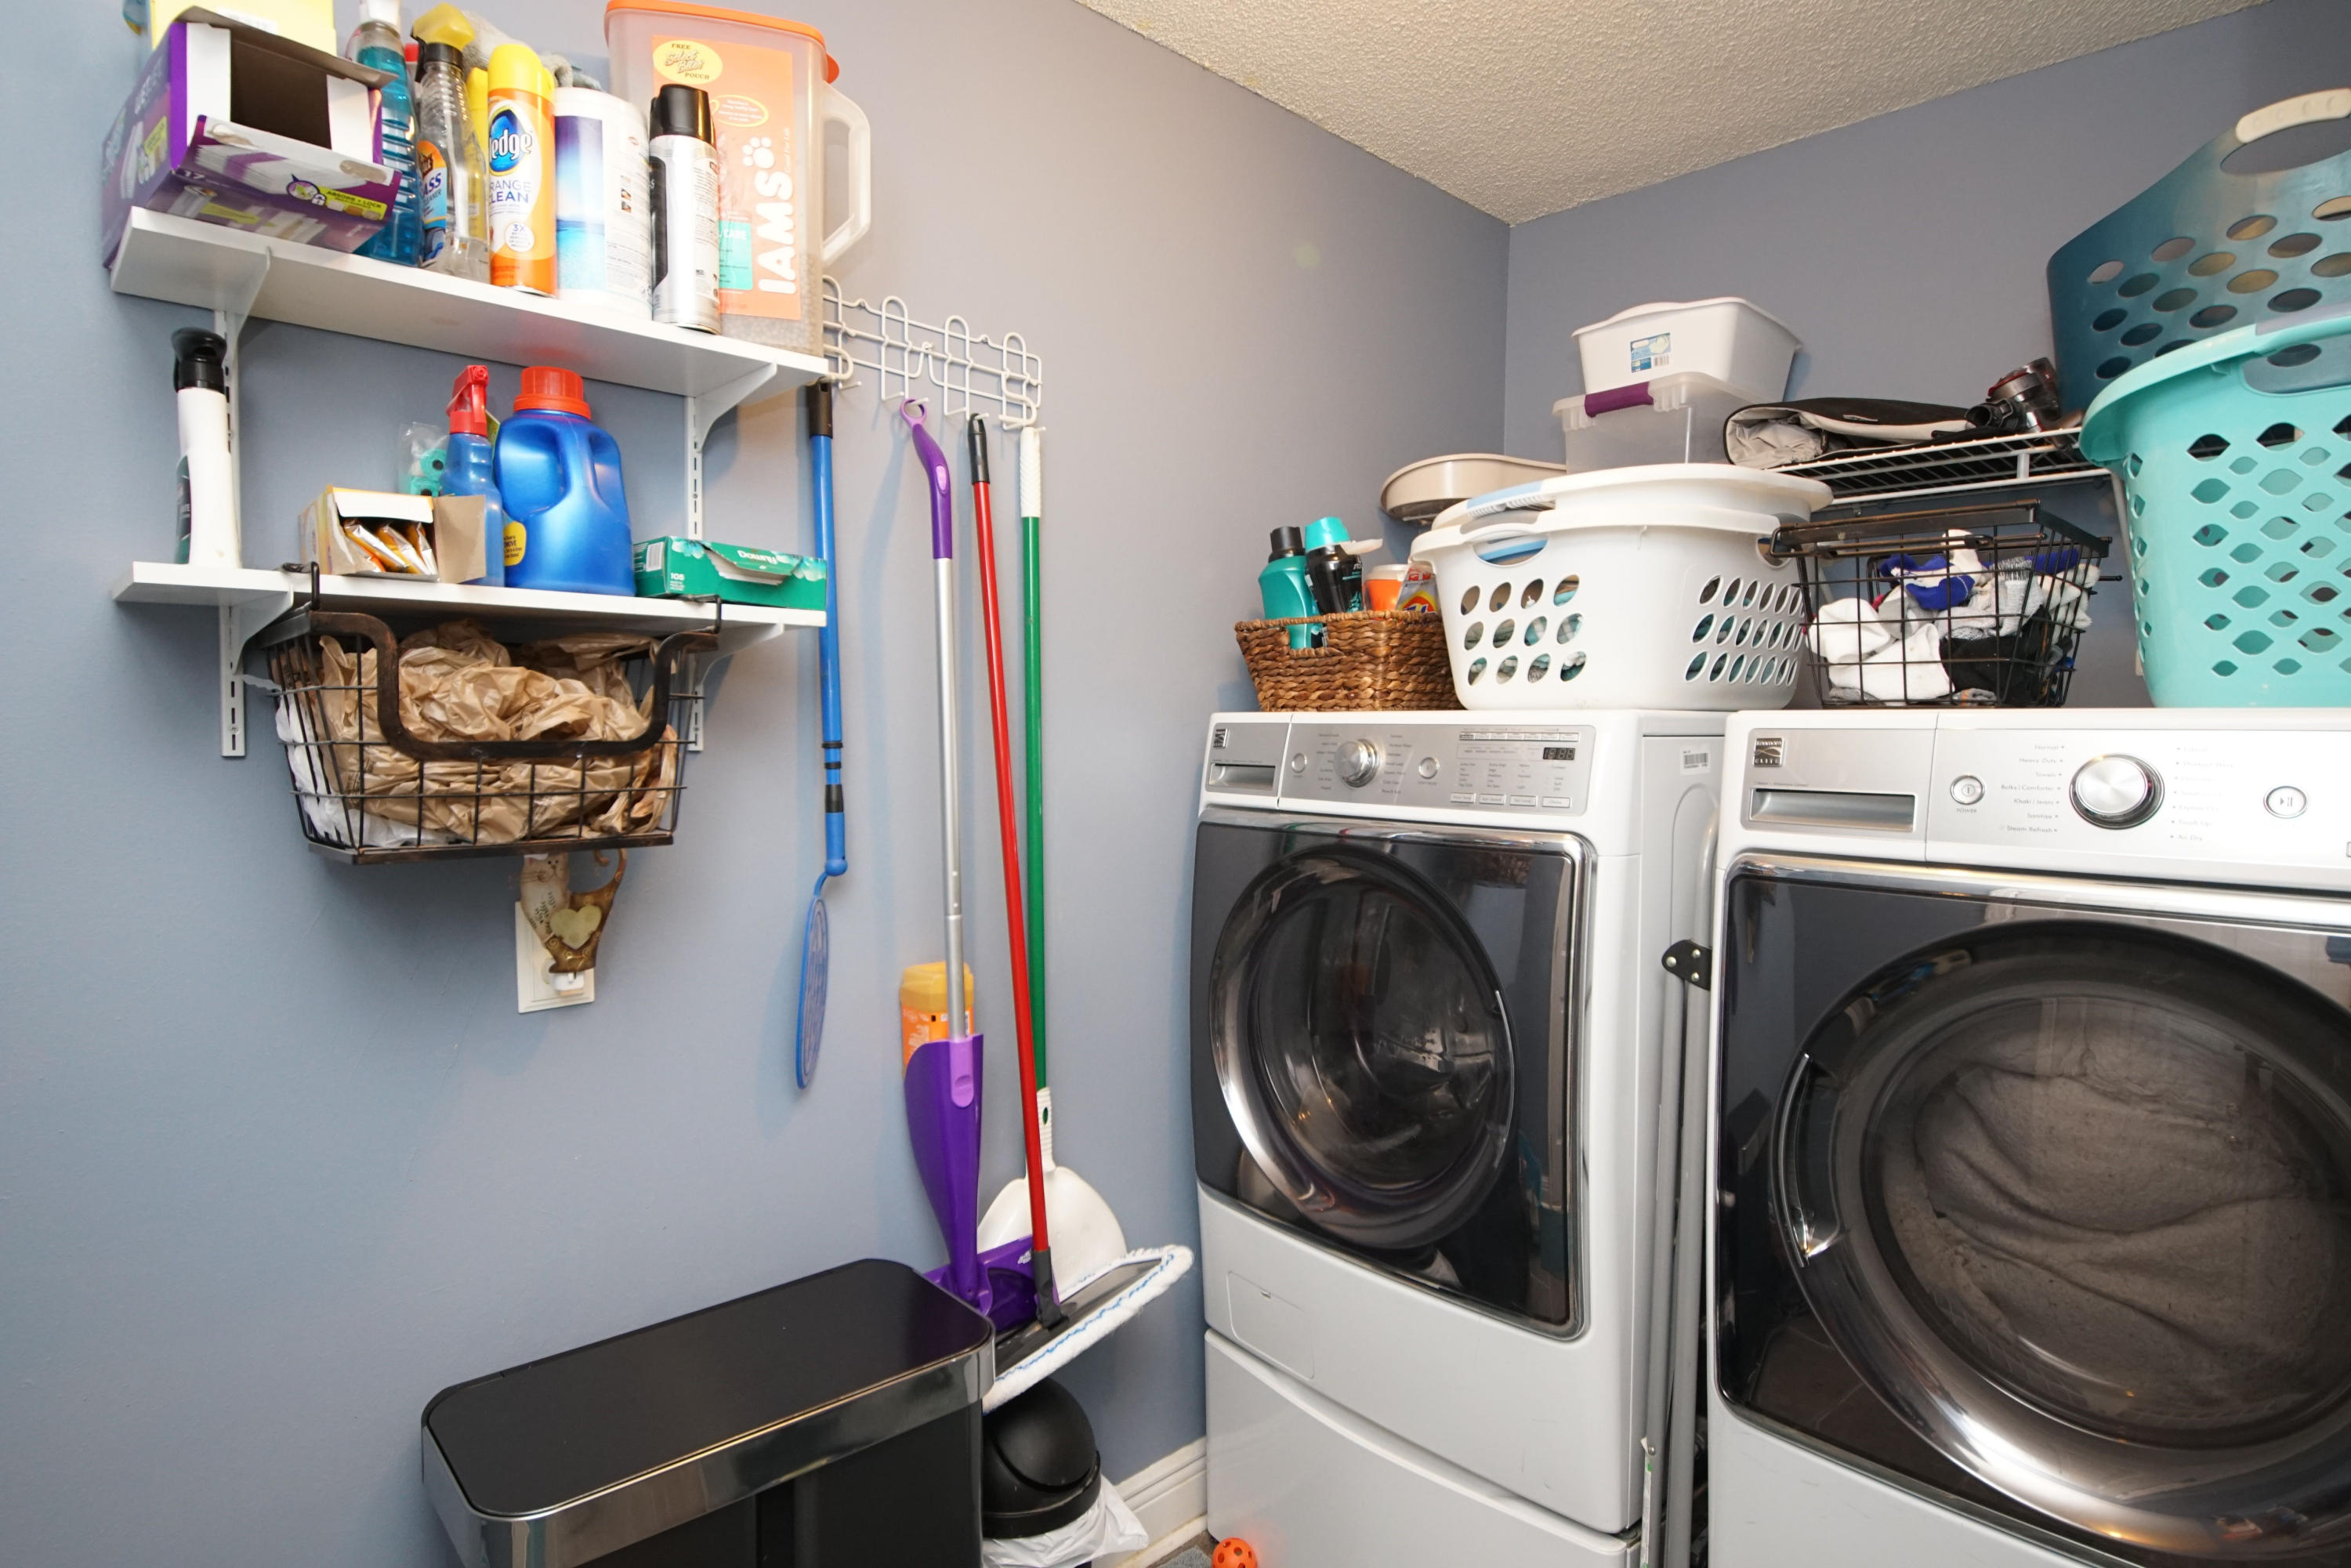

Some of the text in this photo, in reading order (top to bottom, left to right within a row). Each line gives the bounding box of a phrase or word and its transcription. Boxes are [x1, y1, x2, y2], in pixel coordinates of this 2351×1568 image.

[184, 170, 205, 179] 17
[490, 179, 532, 193] RANGE
[491, 191, 529, 204] LEAN
[363, 200, 382, 208] LOCK
[513, 223, 526, 232] 3X
[755, 170, 797, 295] IAMS
[723, 228, 747, 240] CARE
[737, 549, 778, 565] Downy
